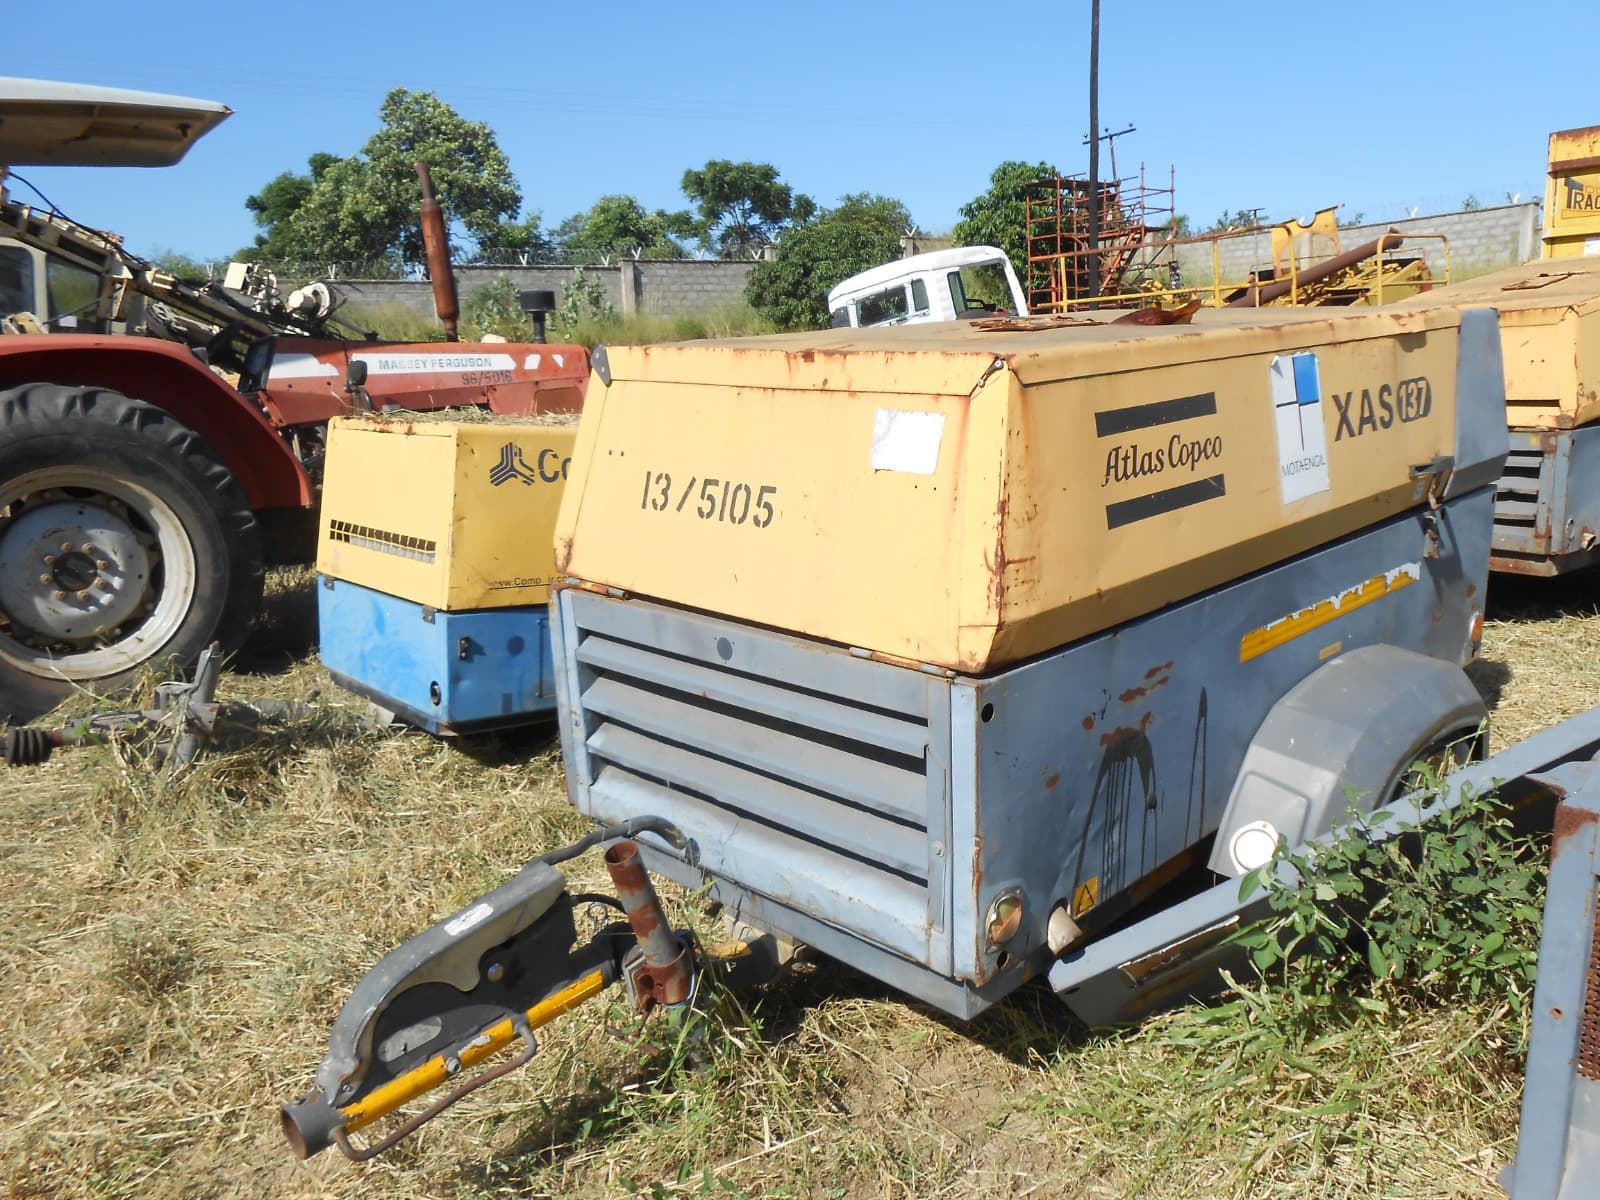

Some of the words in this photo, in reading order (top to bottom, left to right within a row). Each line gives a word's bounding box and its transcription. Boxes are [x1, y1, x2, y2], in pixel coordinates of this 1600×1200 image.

[431, 357, 493, 368] FERGUSON
[1332, 383, 1394, 442] XAS
[1399, 380, 1428, 421] 137
[1101, 444, 1165, 488] Atlas
[1168, 433, 1222, 472] Copco
[641, 471, 777, 528] 13/5105
